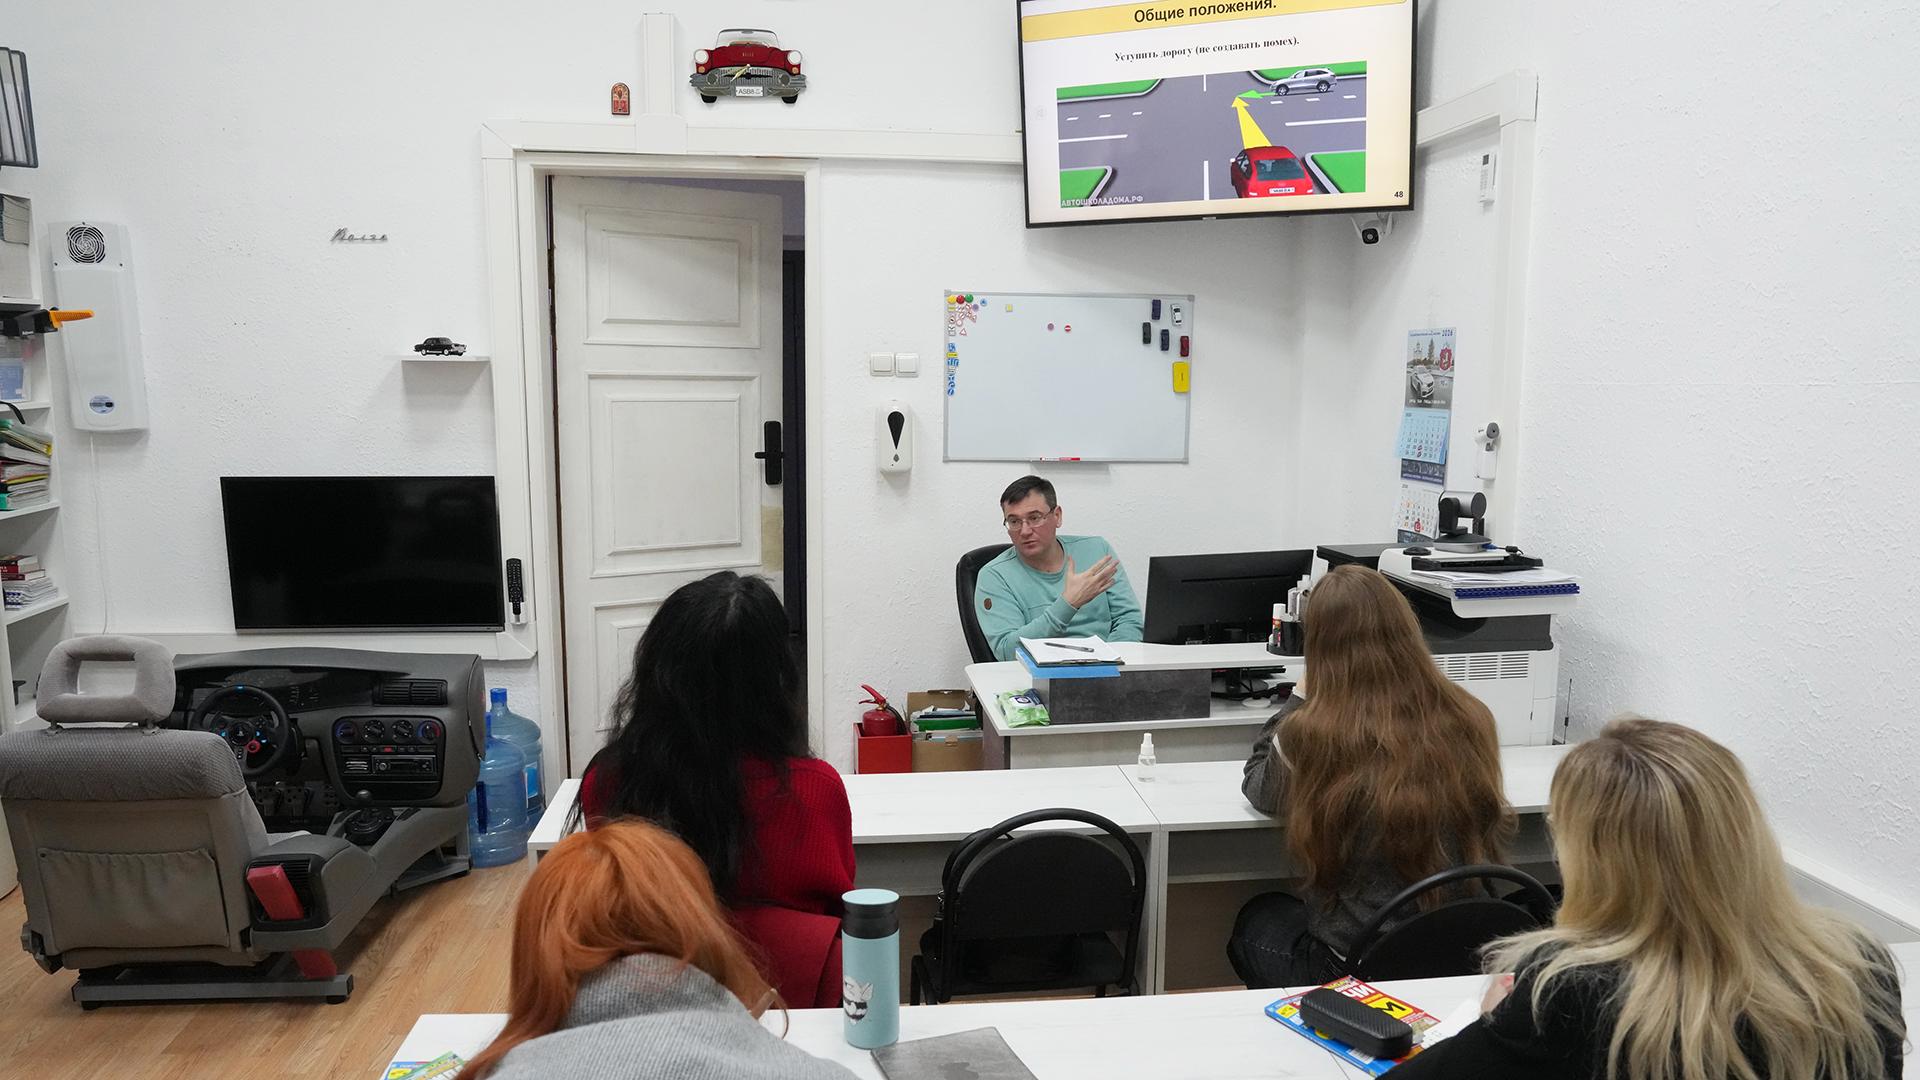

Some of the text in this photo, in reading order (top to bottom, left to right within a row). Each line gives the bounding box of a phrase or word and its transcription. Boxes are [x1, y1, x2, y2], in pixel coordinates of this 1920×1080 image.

[1134, 0, 1277, 23] Общие положения.
[1114, 36, 1300, 63] Уступить дорогу (не создавать помех).
[1061, 195, 1144, 207] АВТОШКОЛАДОМА.РФ
